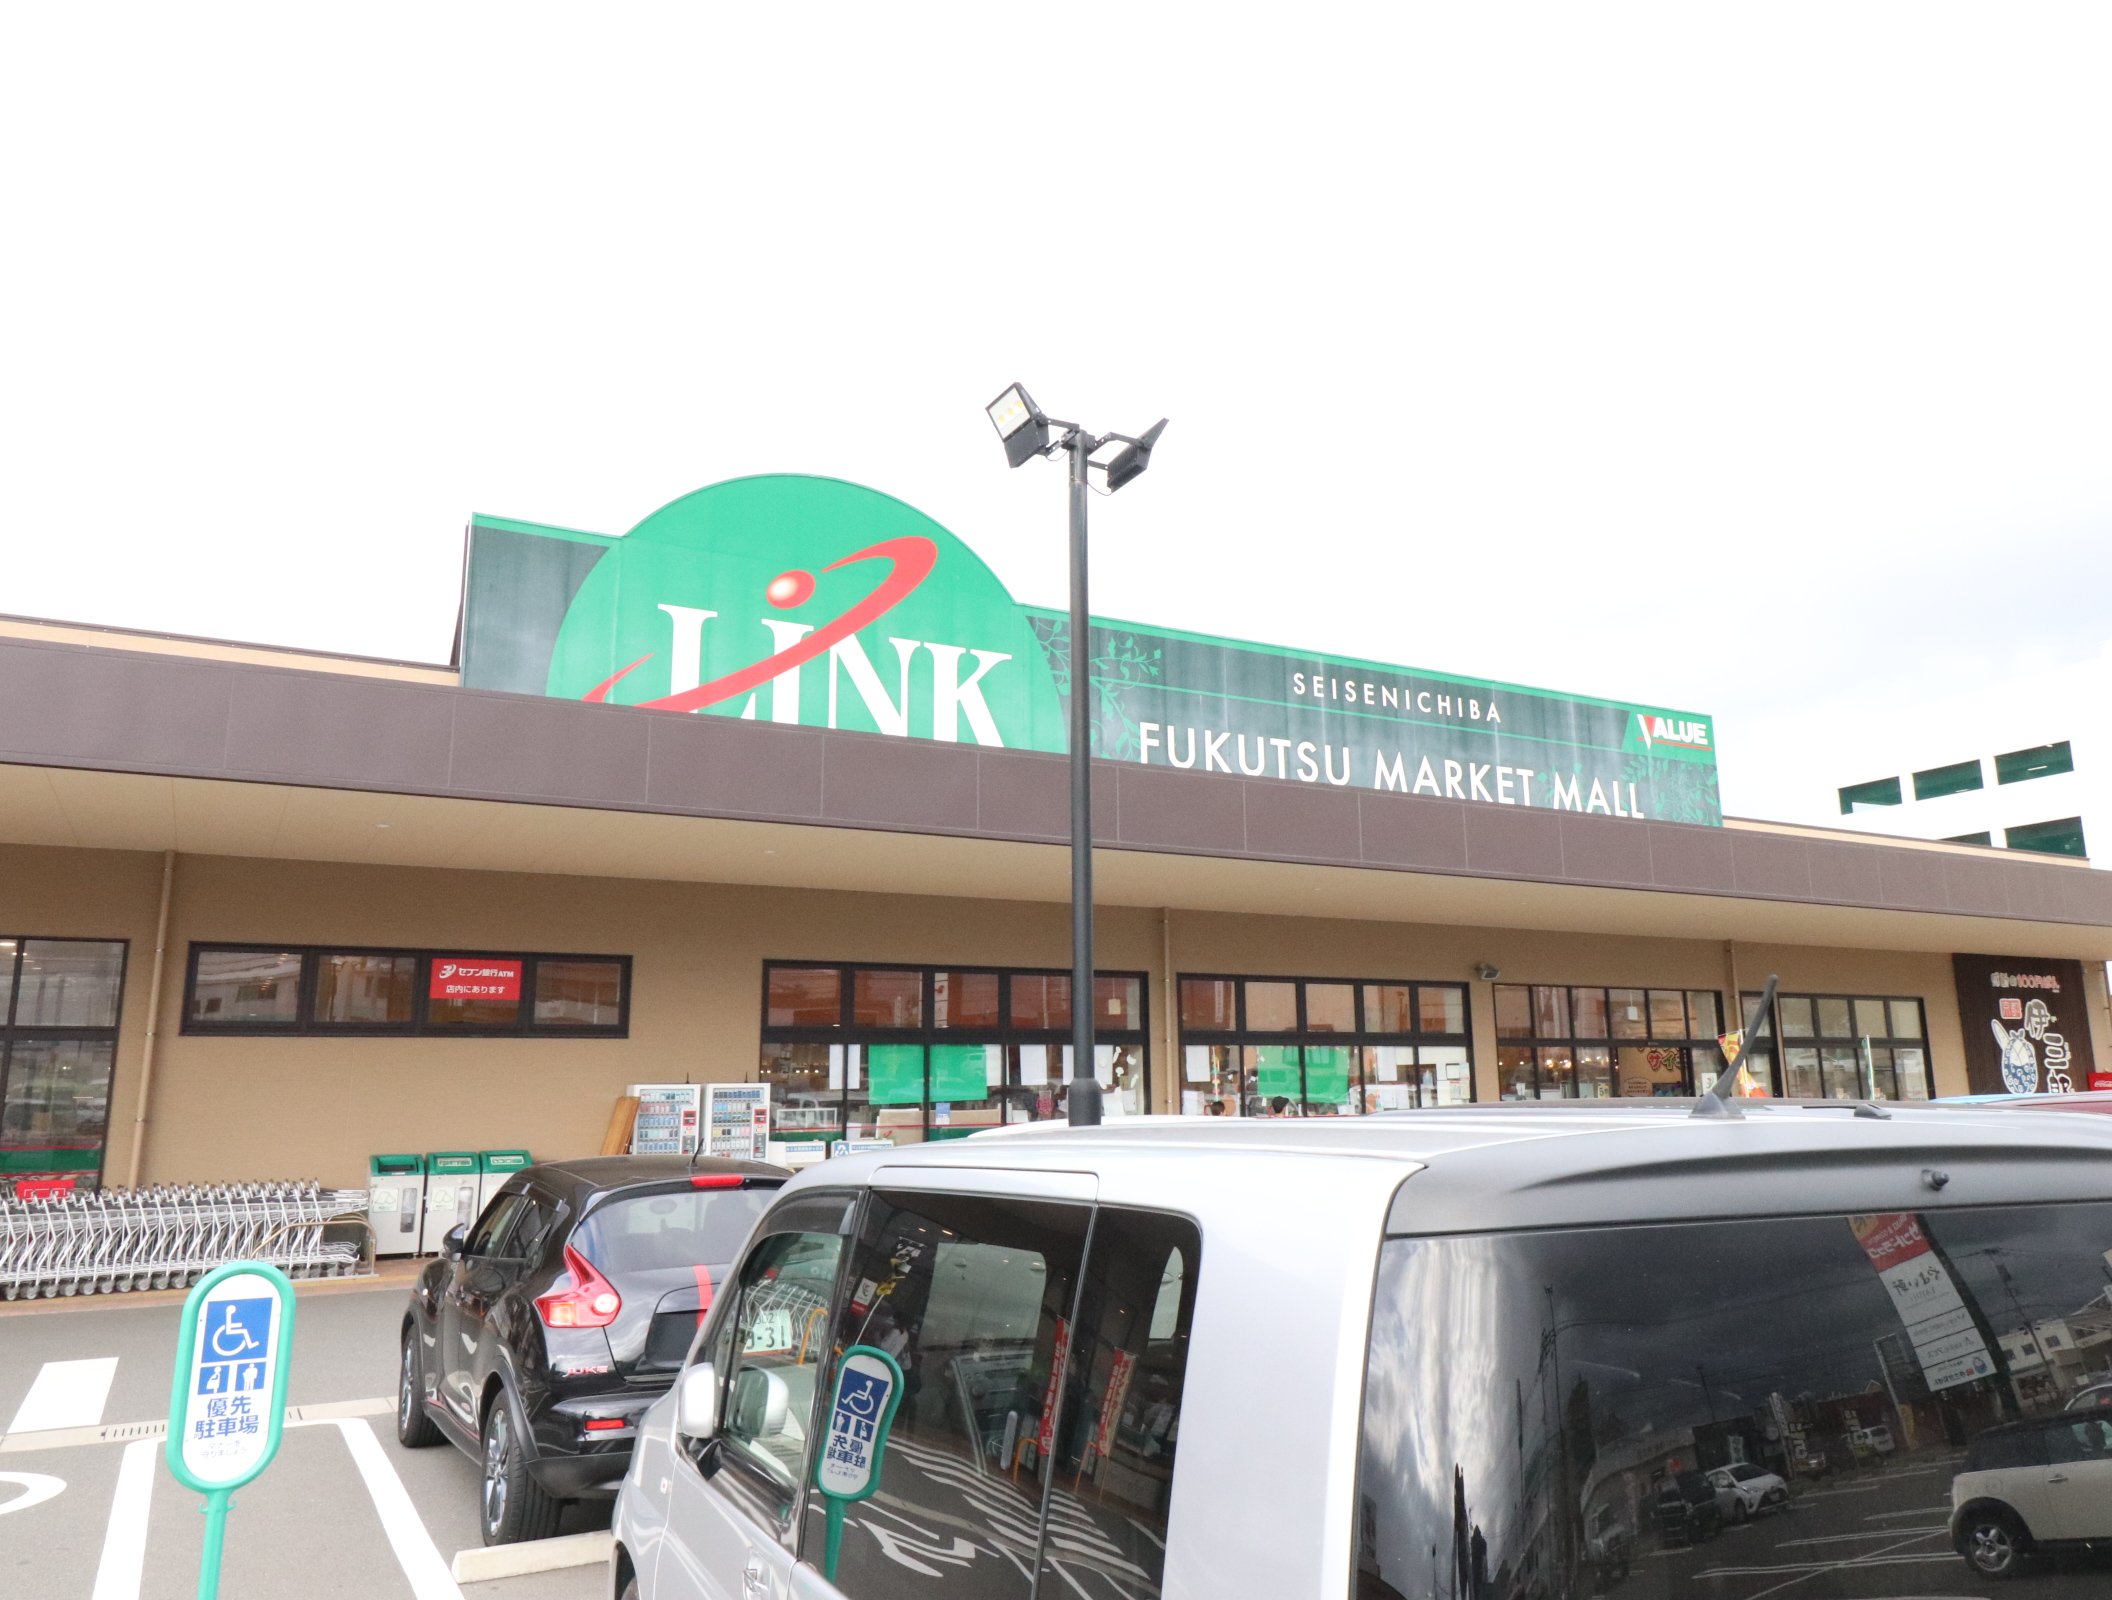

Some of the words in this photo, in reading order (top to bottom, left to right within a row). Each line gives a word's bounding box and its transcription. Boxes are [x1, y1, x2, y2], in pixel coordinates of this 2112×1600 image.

[1291, 671, 1503, 724] SEISENICHIBA
[1636, 713, 1709, 750] VALUE
[1138, 720, 1353, 787] FUKUTSU
[1373, 749, 1535, 806] MARKET
[1553, 771, 1646, 820] MALL
[458, 967, 515, 978] セブン銀行ATM
[445, 984, 506, 995] 店内にあります
[206, 1395, 252, 1419] 優先
[194, 1415, 260, 1440] 駐車場
